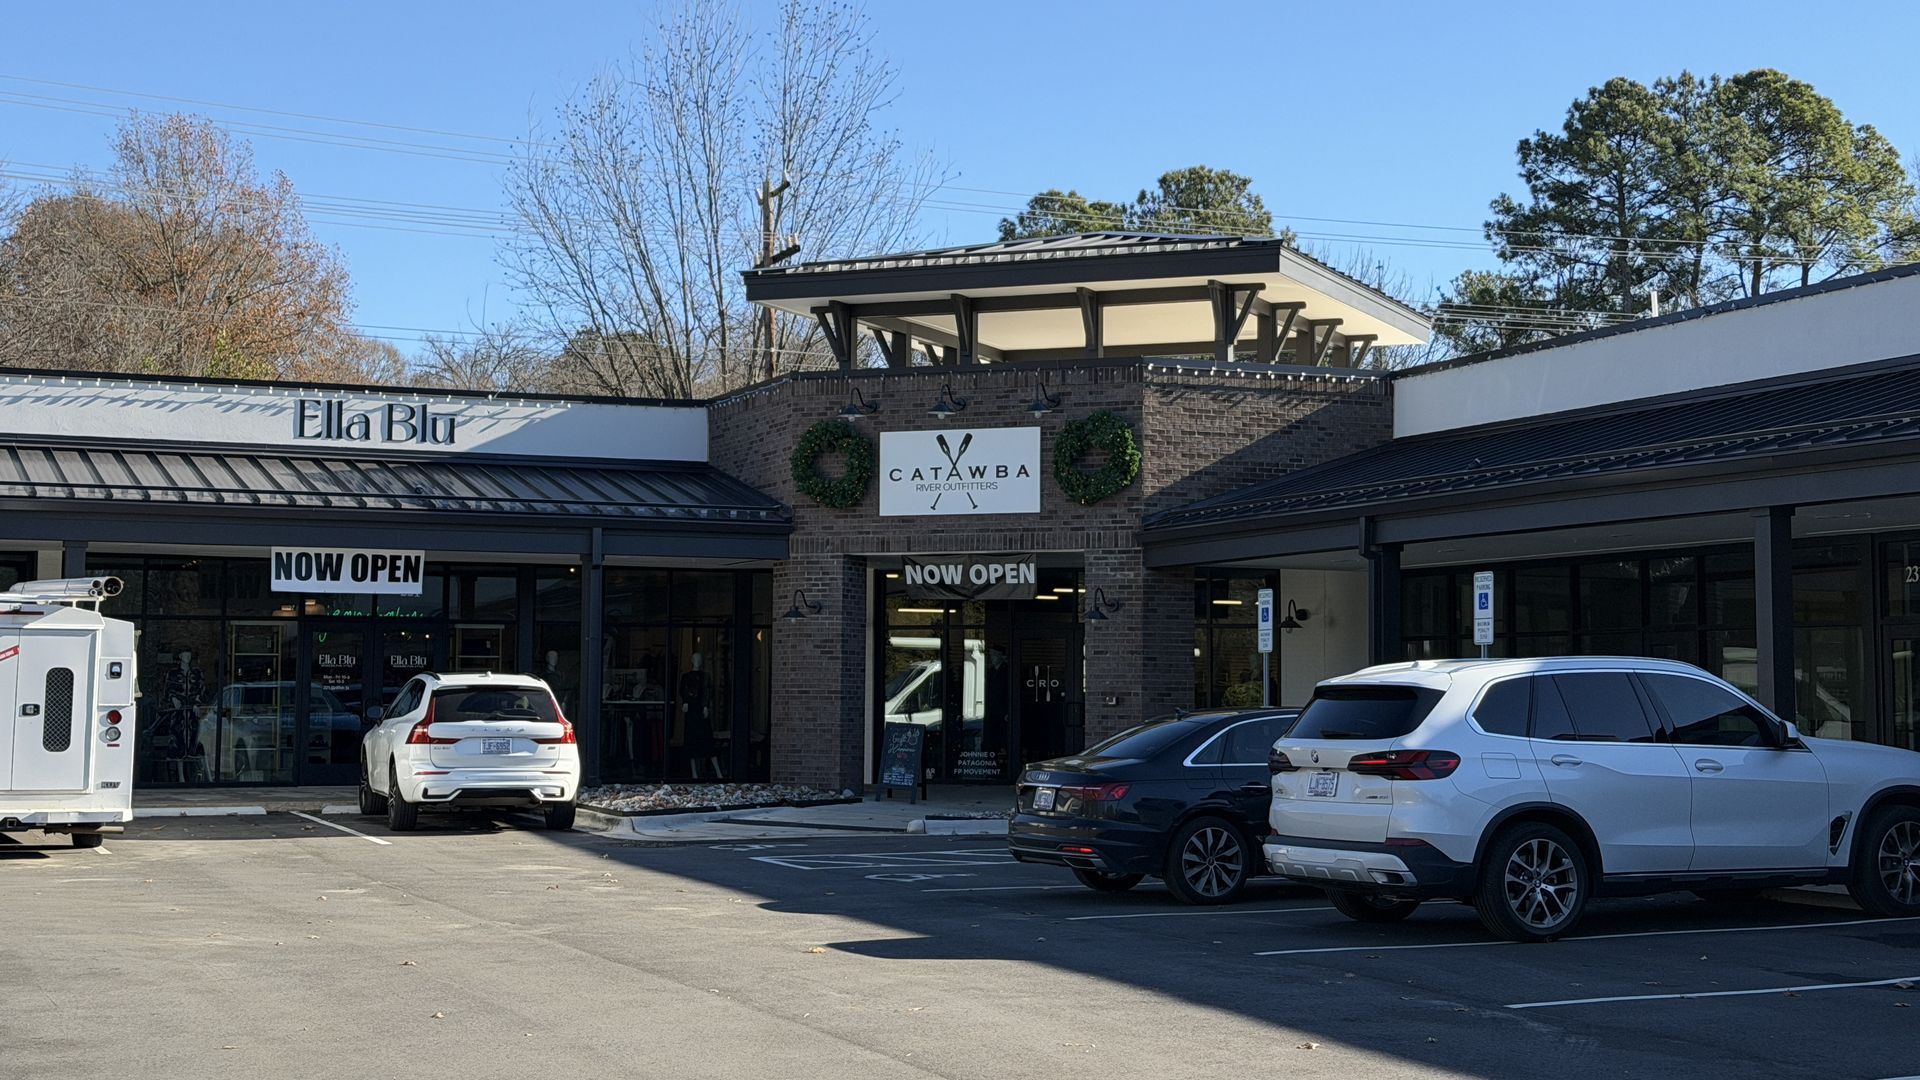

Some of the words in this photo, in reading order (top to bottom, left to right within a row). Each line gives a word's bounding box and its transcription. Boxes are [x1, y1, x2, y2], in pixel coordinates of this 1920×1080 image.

[298, 399, 370, 440] Ella
[889, 464, 1030, 482] CATAWBA
[916, 483, 941, 492] RIVER
[943, 481, 998, 491] OUTFITTERS
[274, 551, 344, 581] NOW
[350, 553, 421, 583] OPEN
[904, 564, 963, 585] NOW
[969, 563, 1035, 585] OPEN
[1905, 565, 1920, 583] 23
[318, 654, 337, 665] Ella
[390, 655, 408, 665] Ella
[957, 759, 997, 767] PATAGONIA
